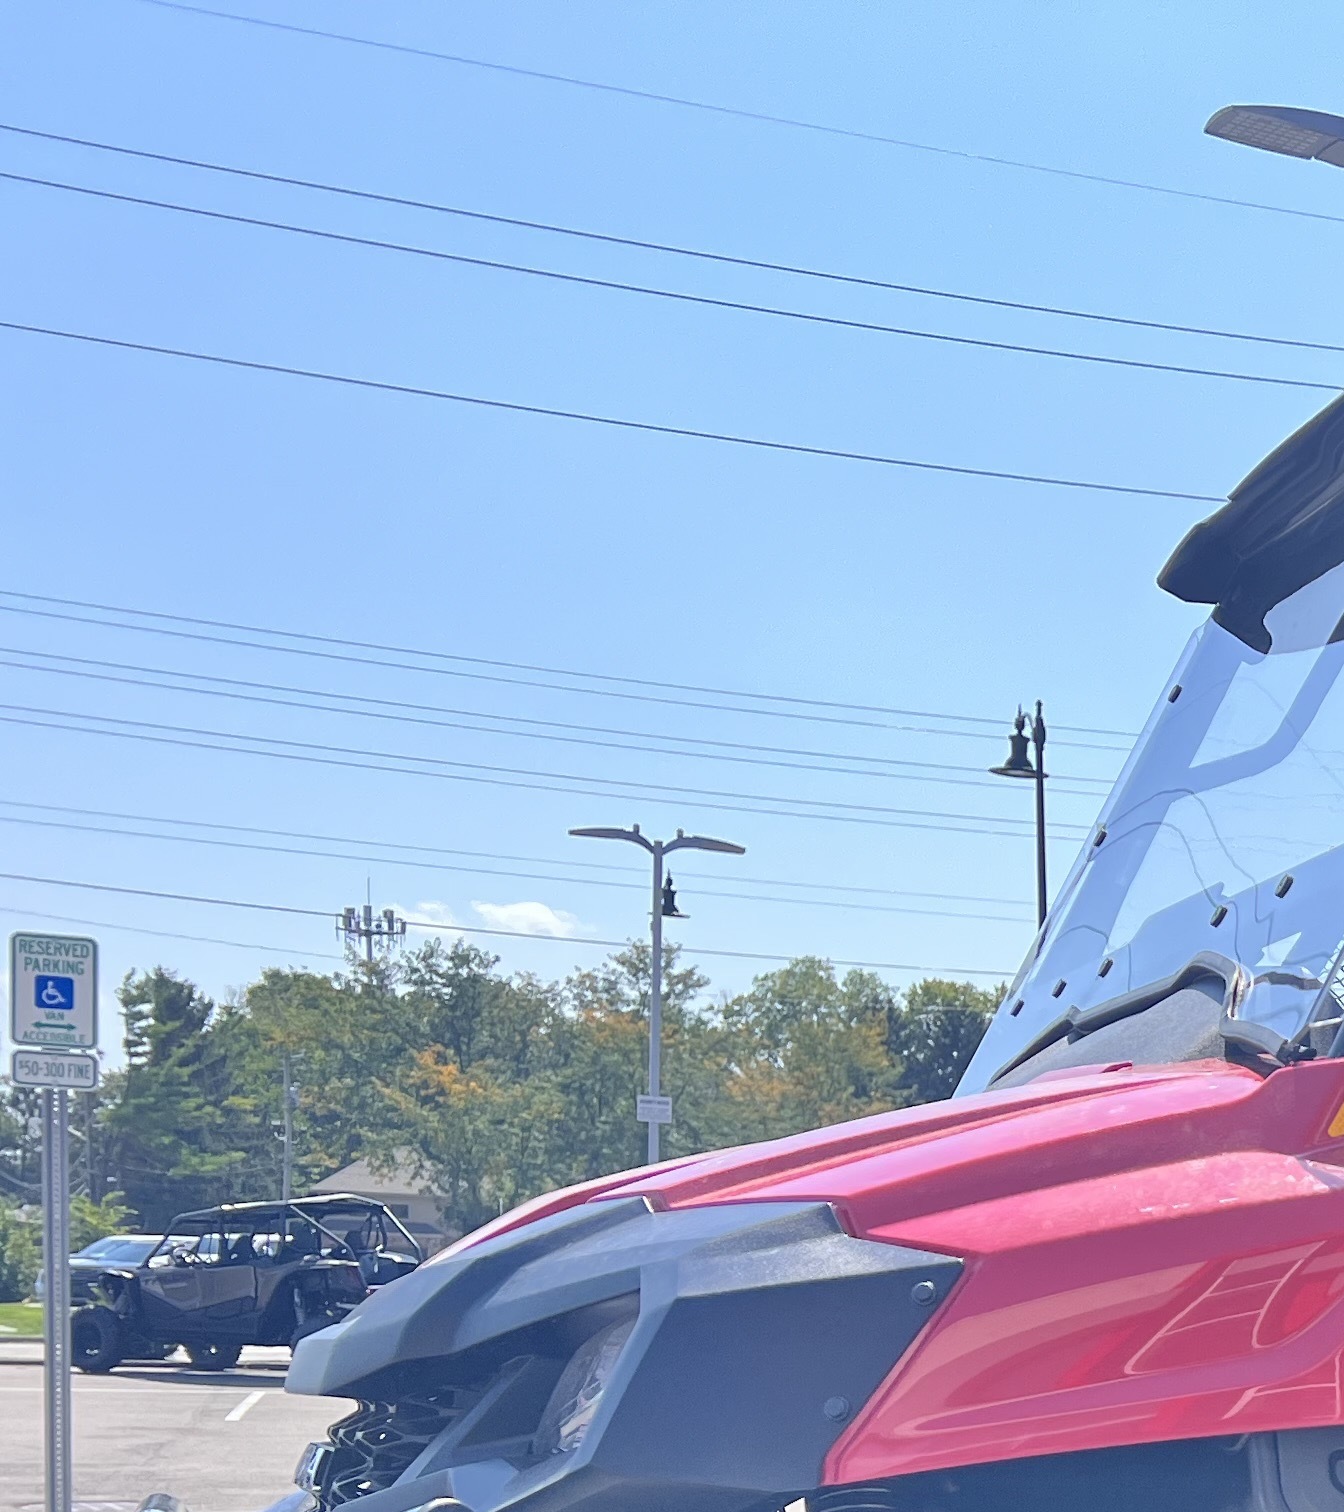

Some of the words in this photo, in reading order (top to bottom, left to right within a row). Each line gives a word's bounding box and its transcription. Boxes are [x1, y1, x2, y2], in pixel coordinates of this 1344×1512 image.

[19, 940, 90, 958] RESERVED
[23, 956, 85, 975] PARKING
[44, 1011, 65, 1021] VAN
[67, 1063, 91, 1080] FINE
